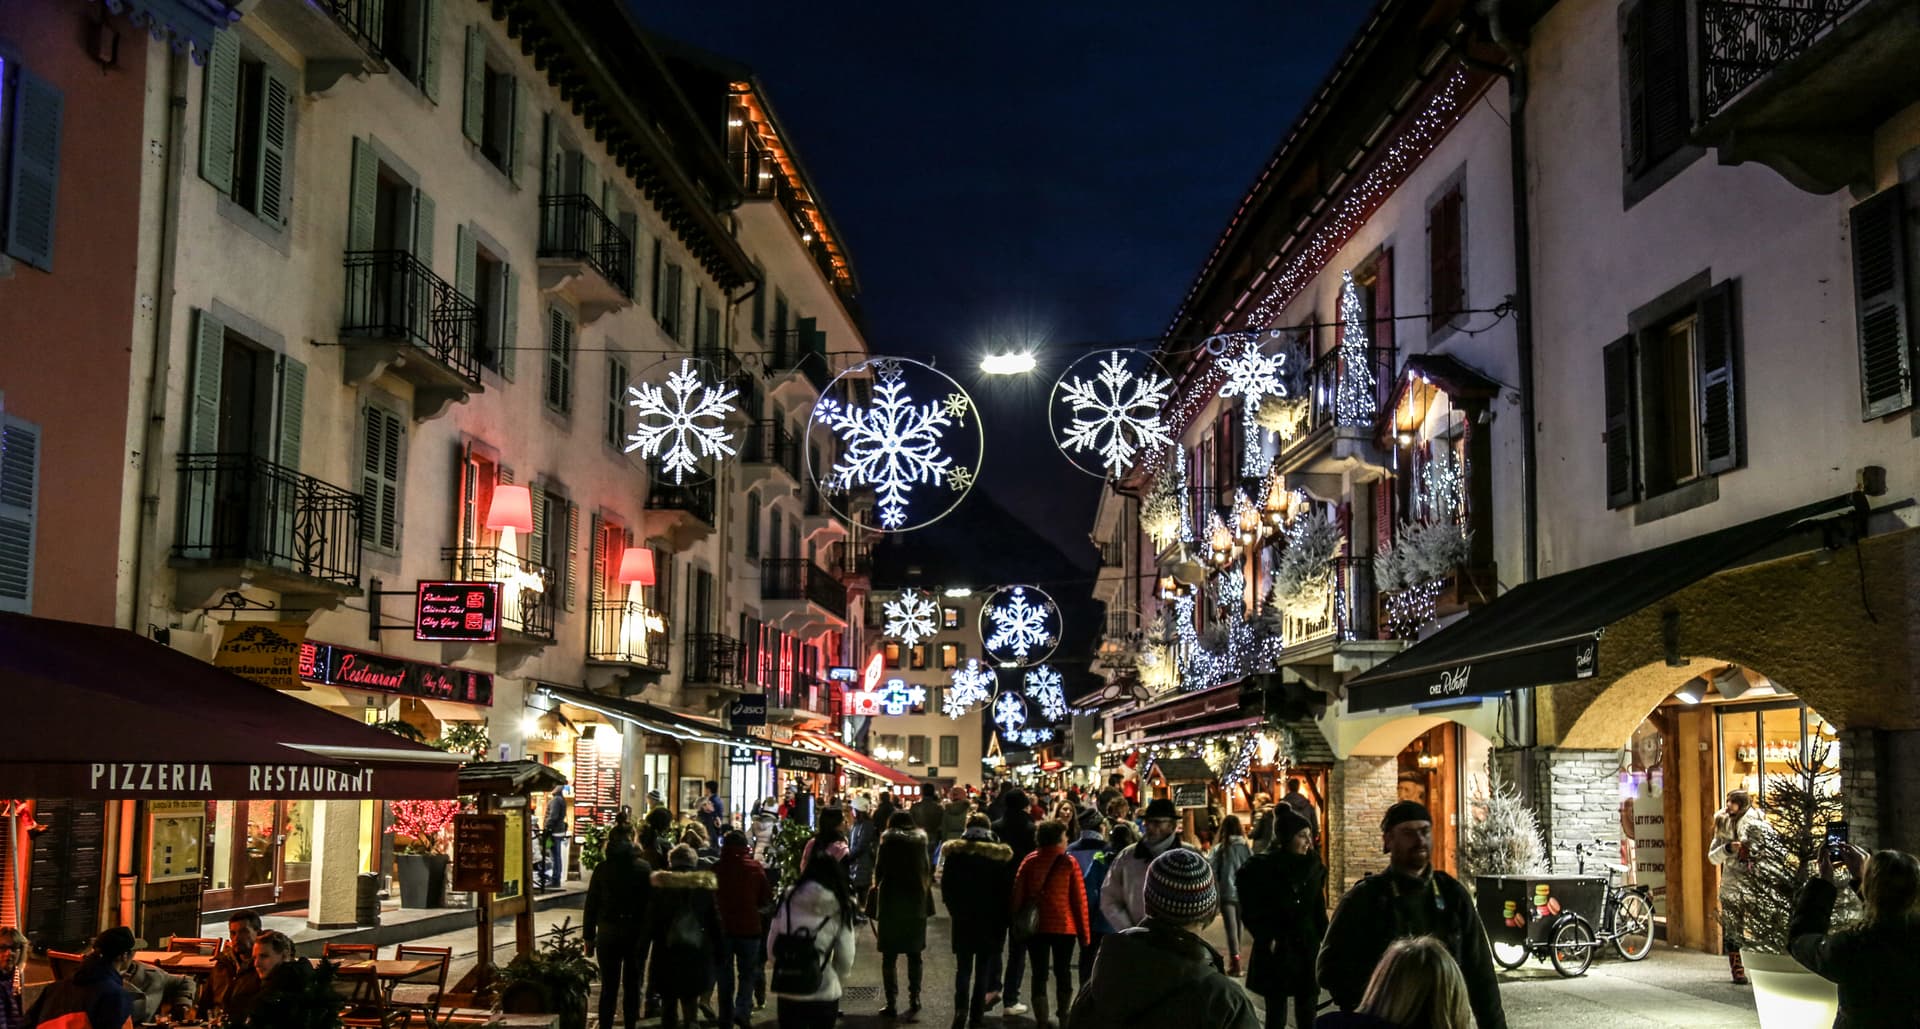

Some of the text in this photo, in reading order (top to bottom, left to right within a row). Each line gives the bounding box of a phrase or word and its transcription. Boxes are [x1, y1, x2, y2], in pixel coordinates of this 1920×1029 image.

[336, 653, 407, 688] Restaurant
[91, 763, 213, 791] PIZZERIA
[249, 765, 374, 792] RESTAURANT
